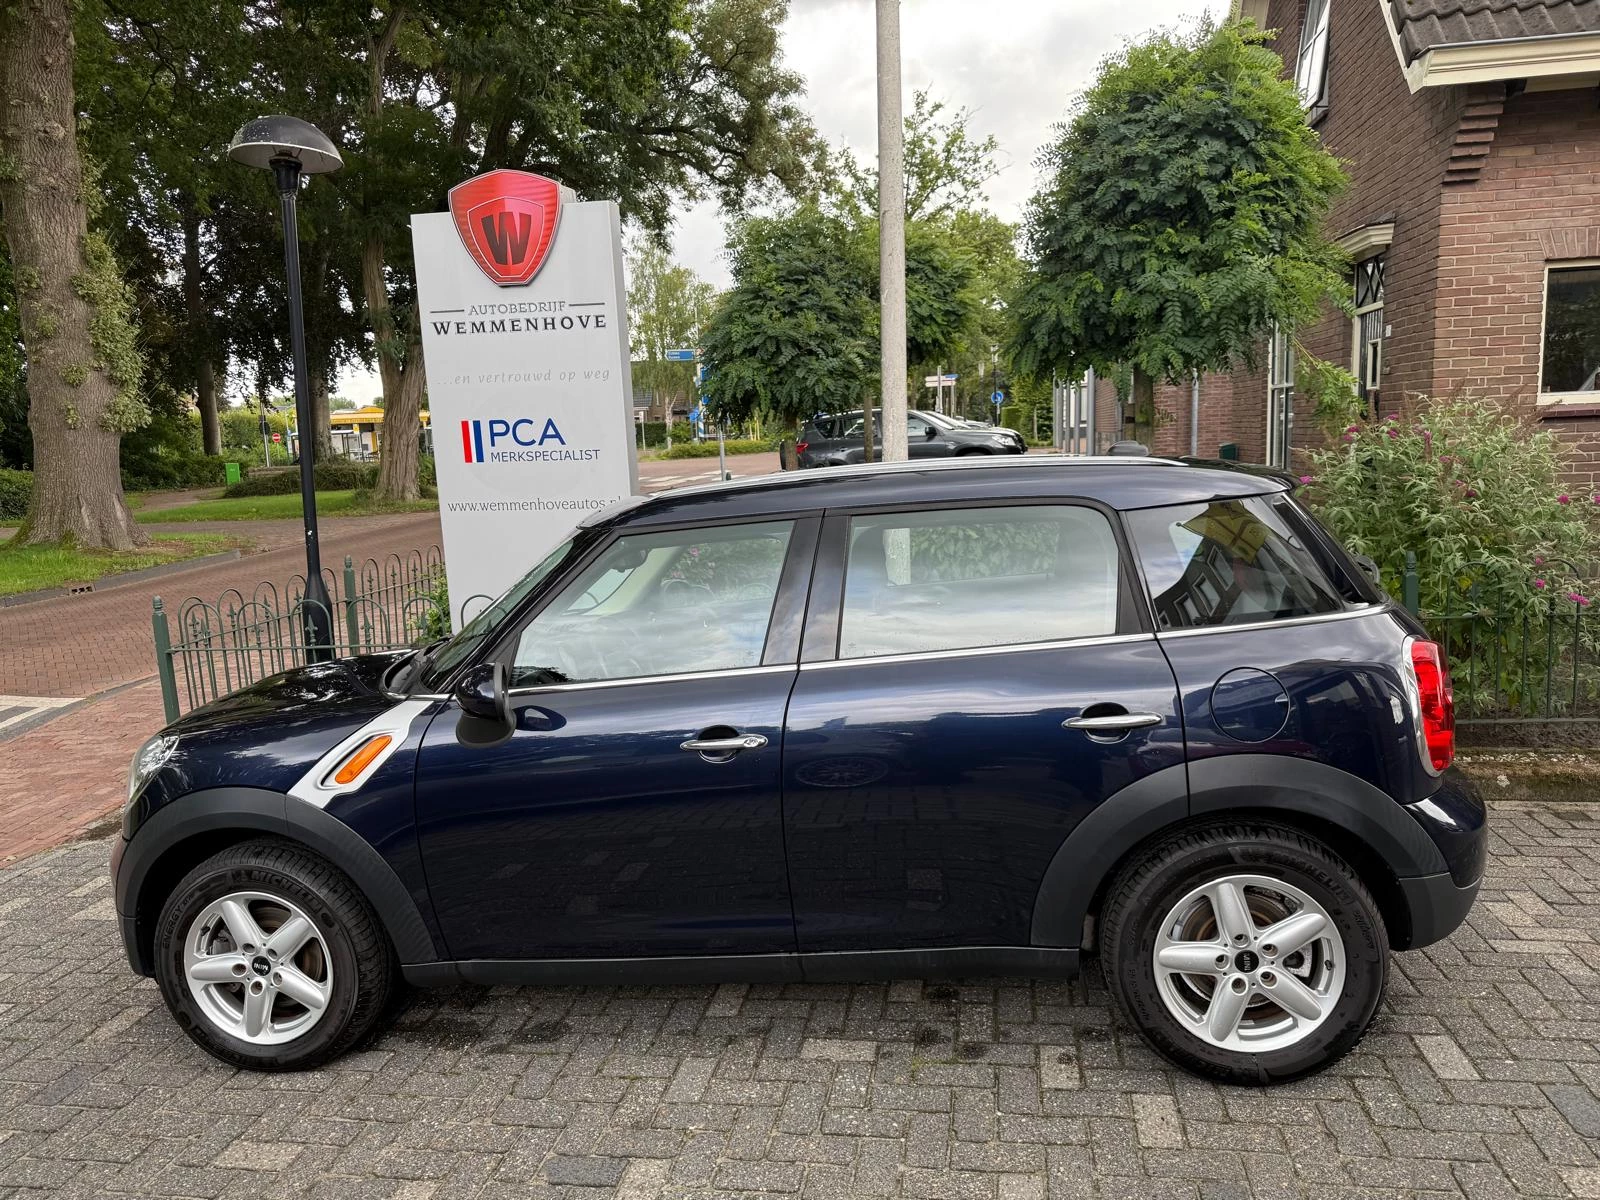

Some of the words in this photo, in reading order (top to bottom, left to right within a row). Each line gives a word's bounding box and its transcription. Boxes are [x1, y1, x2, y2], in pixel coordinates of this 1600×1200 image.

[481, 211, 532, 265] W
[468, 301, 565, 315] AUTOBEDRIJF
[433, 315, 607, 335] WEMMENHOVE
[479, 369, 551, 383] vertrouwd
[559, 370, 576, 382] op
[583, 369, 610, 382] weg
[489, 418, 566, 447] PCA
[491, 450, 600, 462] MERKSPECIALIST
[448, 496, 620, 512] www.wemmenhoveautos
[162, 907, 184, 949] ENERGY
